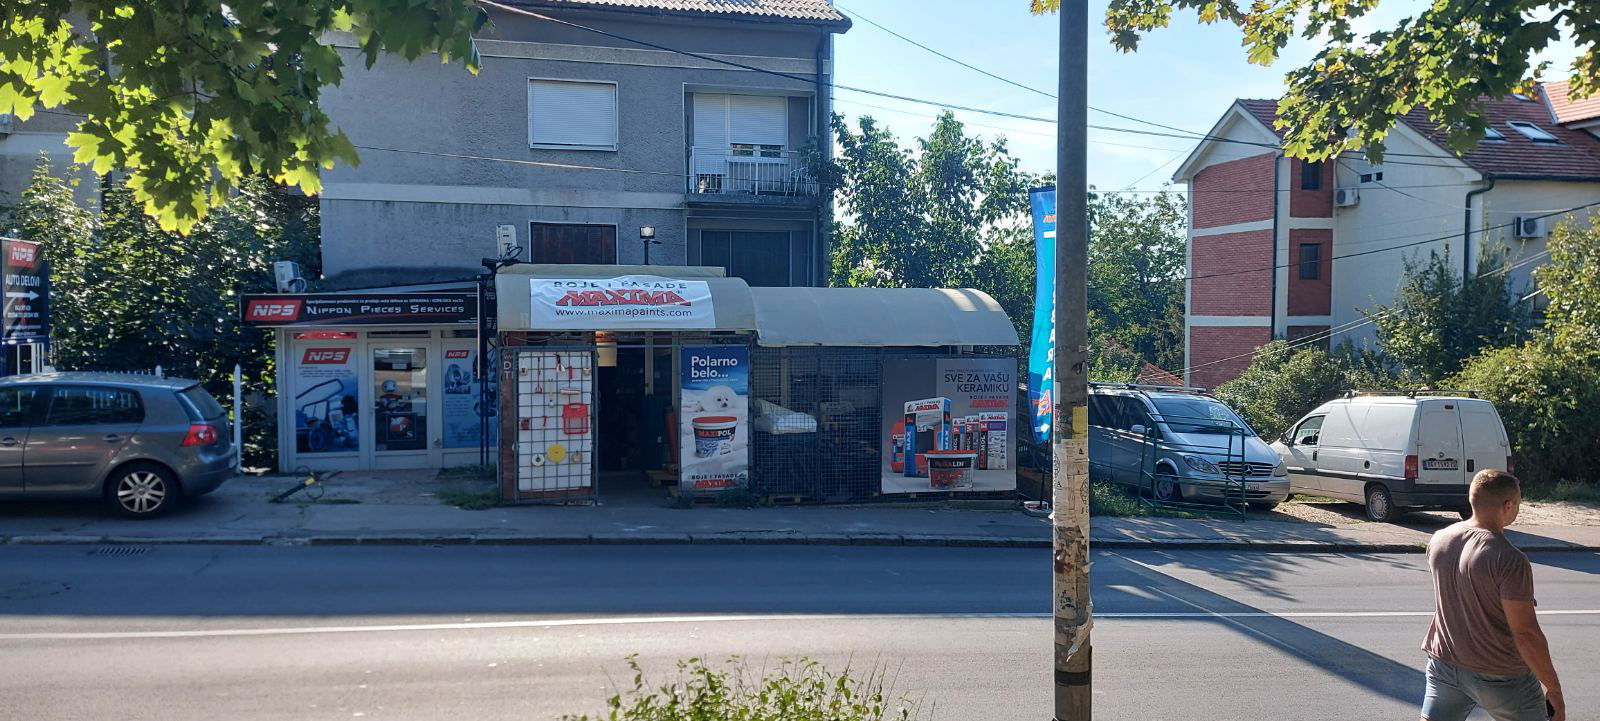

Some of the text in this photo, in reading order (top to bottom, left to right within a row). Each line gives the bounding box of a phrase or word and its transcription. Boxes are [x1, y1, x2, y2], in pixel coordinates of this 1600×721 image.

[12, 247, 34, 261] NPS
[6, 274, 40, 287] AUTO DELOVI
[622, 280, 687, 288] FASADE
[556, 290, 691, 306] MAXIMA
[253, 304, 295, 316] NPS
[306, 306, 352, 314] NIPPON
[410, 304, 464, 313] SERVICES
[556, 308, 692, 318] www.maximapaints.com
[308, 352, 345, 361] NPS
[692, 355, 738, 366] Polarno
[692, 367, 728, 378] belo...
[945, 374, 964, 382] SVE
[966, 374, 980, 382] ZA
[984, 371, 1010, 382] VAŠU
[957, 384, 1010, 392] KERAMIKU
